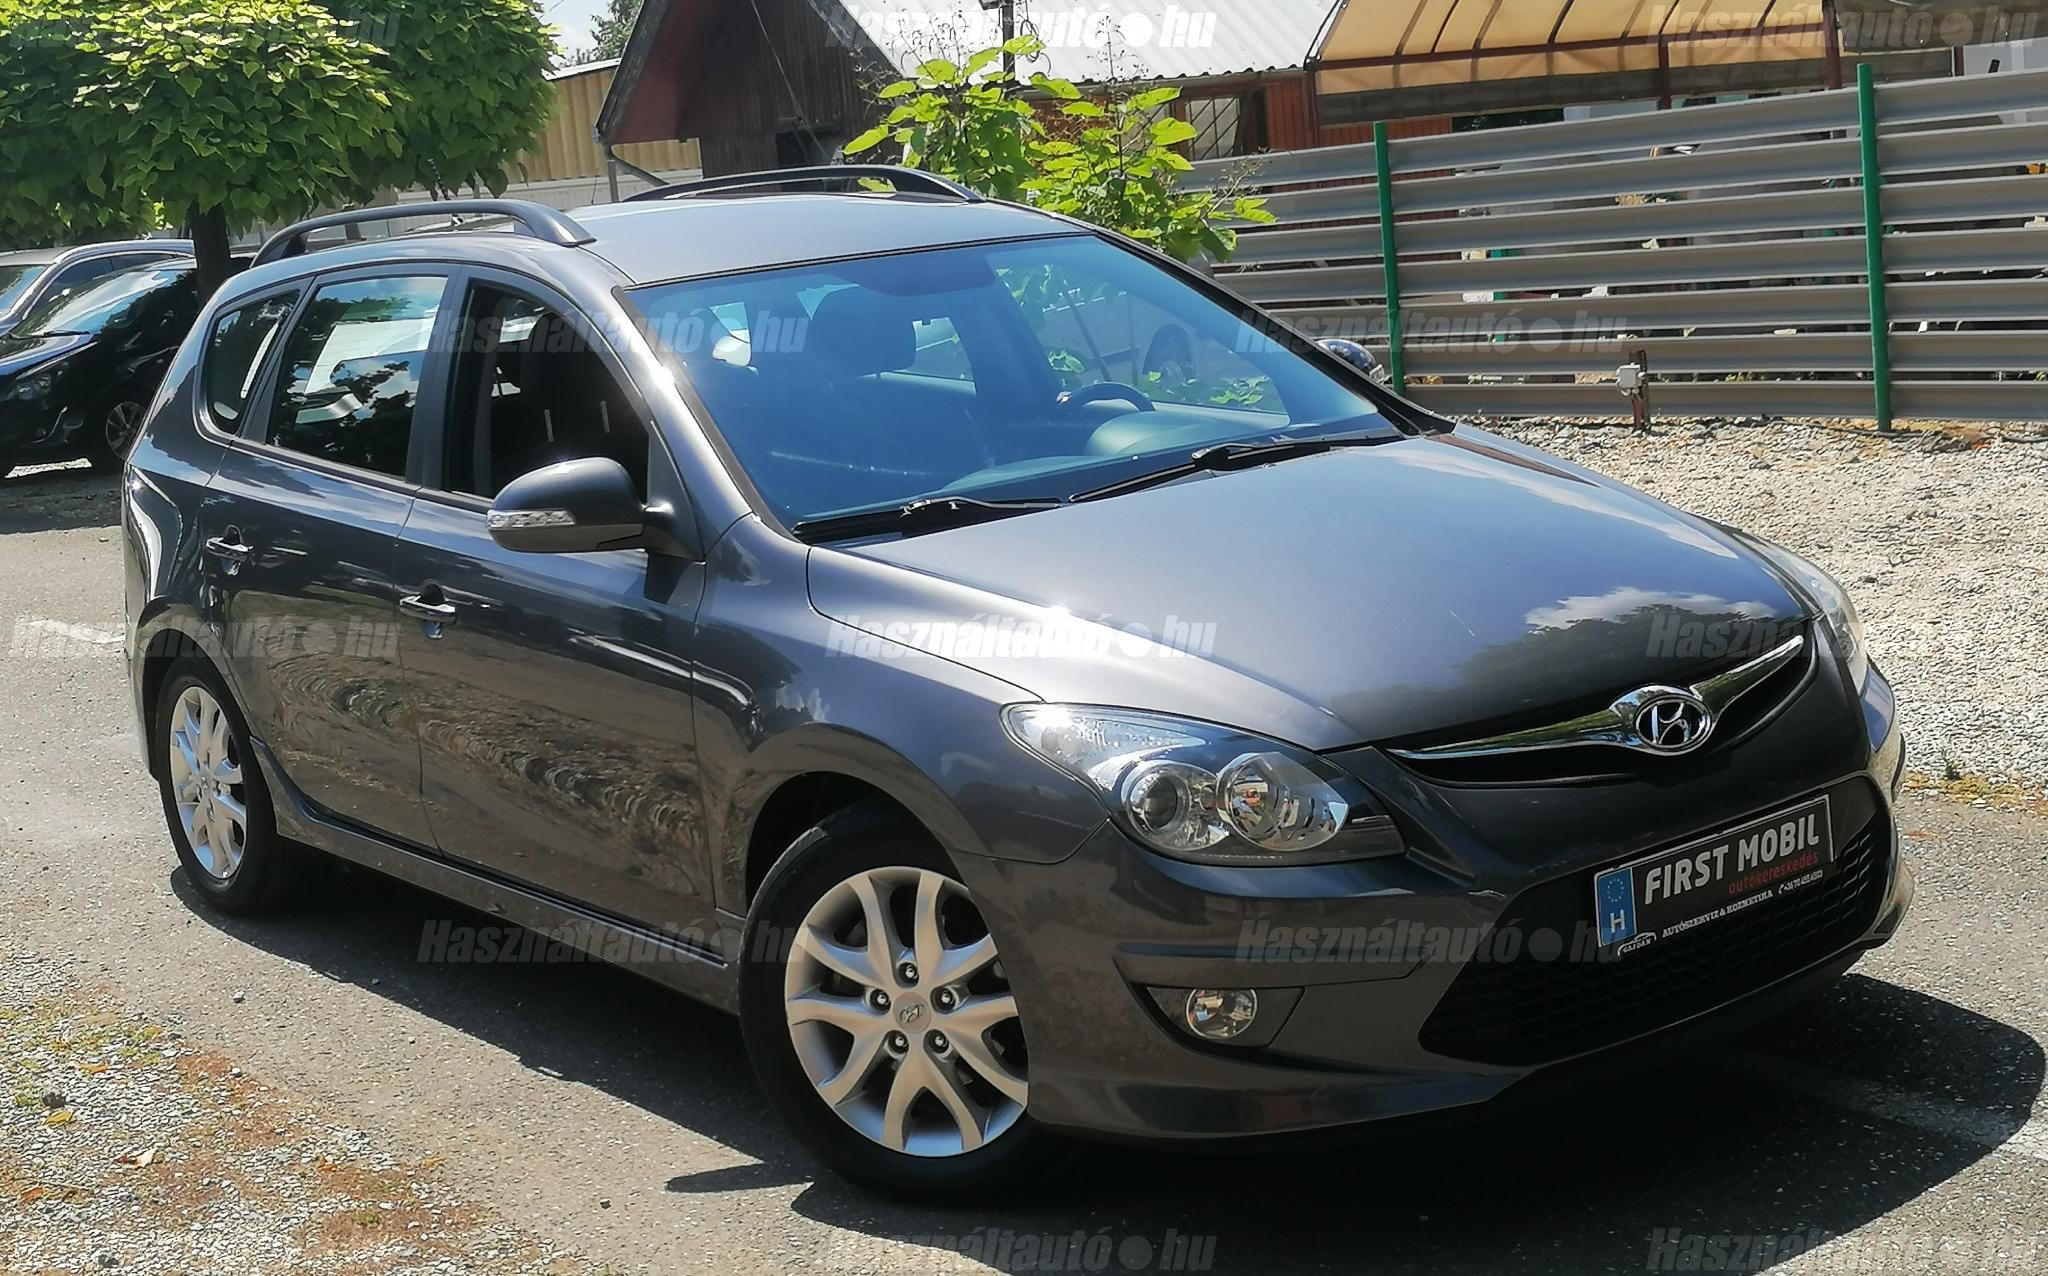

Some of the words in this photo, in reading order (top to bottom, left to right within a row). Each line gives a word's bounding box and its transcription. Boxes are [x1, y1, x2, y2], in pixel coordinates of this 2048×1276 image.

[1645, 845, 1729, 905] FIRST
[1738, 813, 1820, 873] MOBIL
[1610, 909, 1626, 933] H
